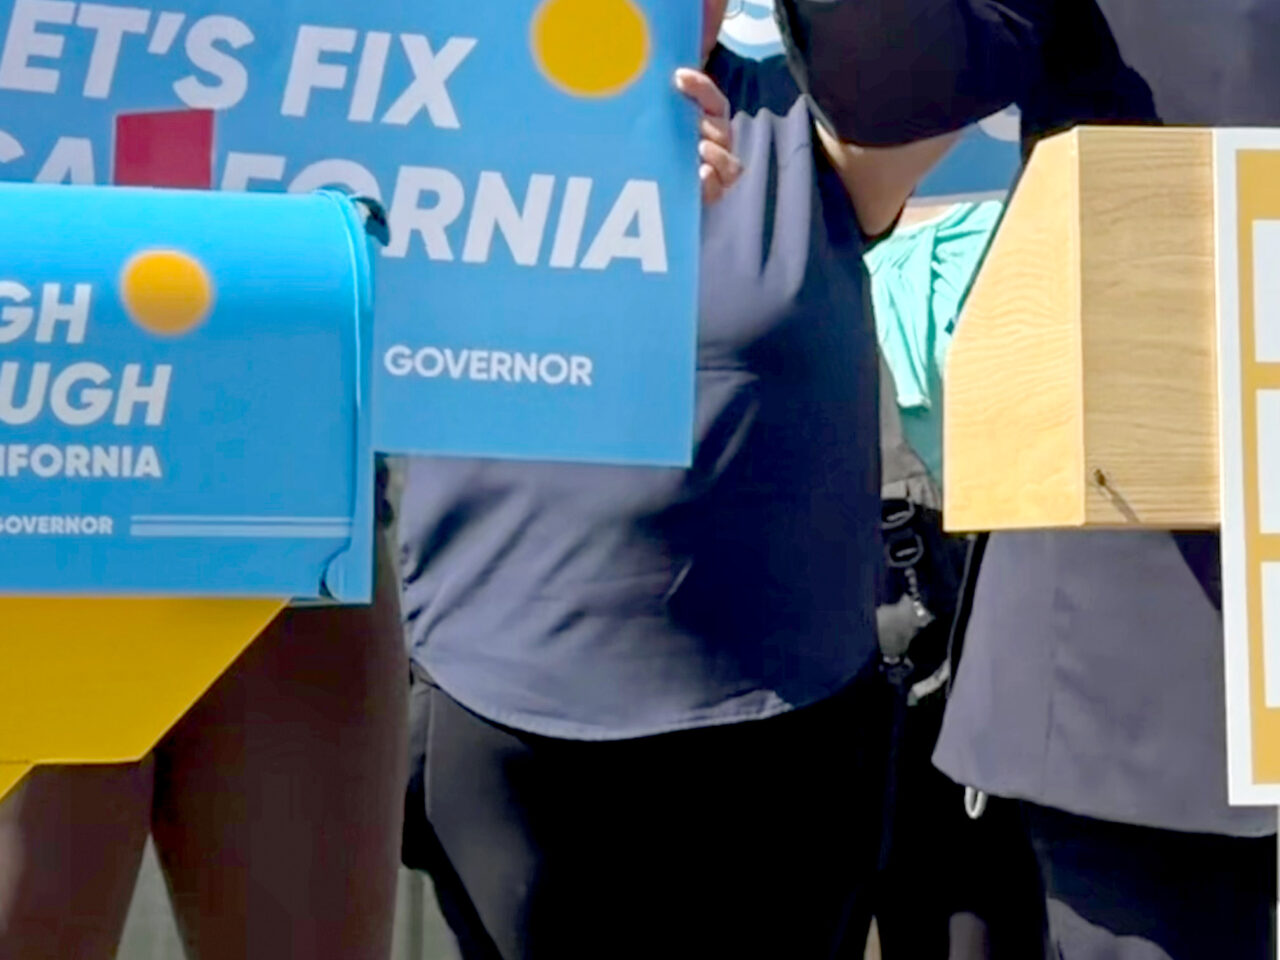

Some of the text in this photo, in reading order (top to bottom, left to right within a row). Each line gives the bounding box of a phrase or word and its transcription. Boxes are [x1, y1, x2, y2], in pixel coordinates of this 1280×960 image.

[280, 24, 478, 130] FIX
[383, 344, 593, 387] GOVERNOR
[0, 361, 173, 426] UGH
[0, 442, 163, 479] FORNIA
[0, 514, 113, 535] OVERNOR
